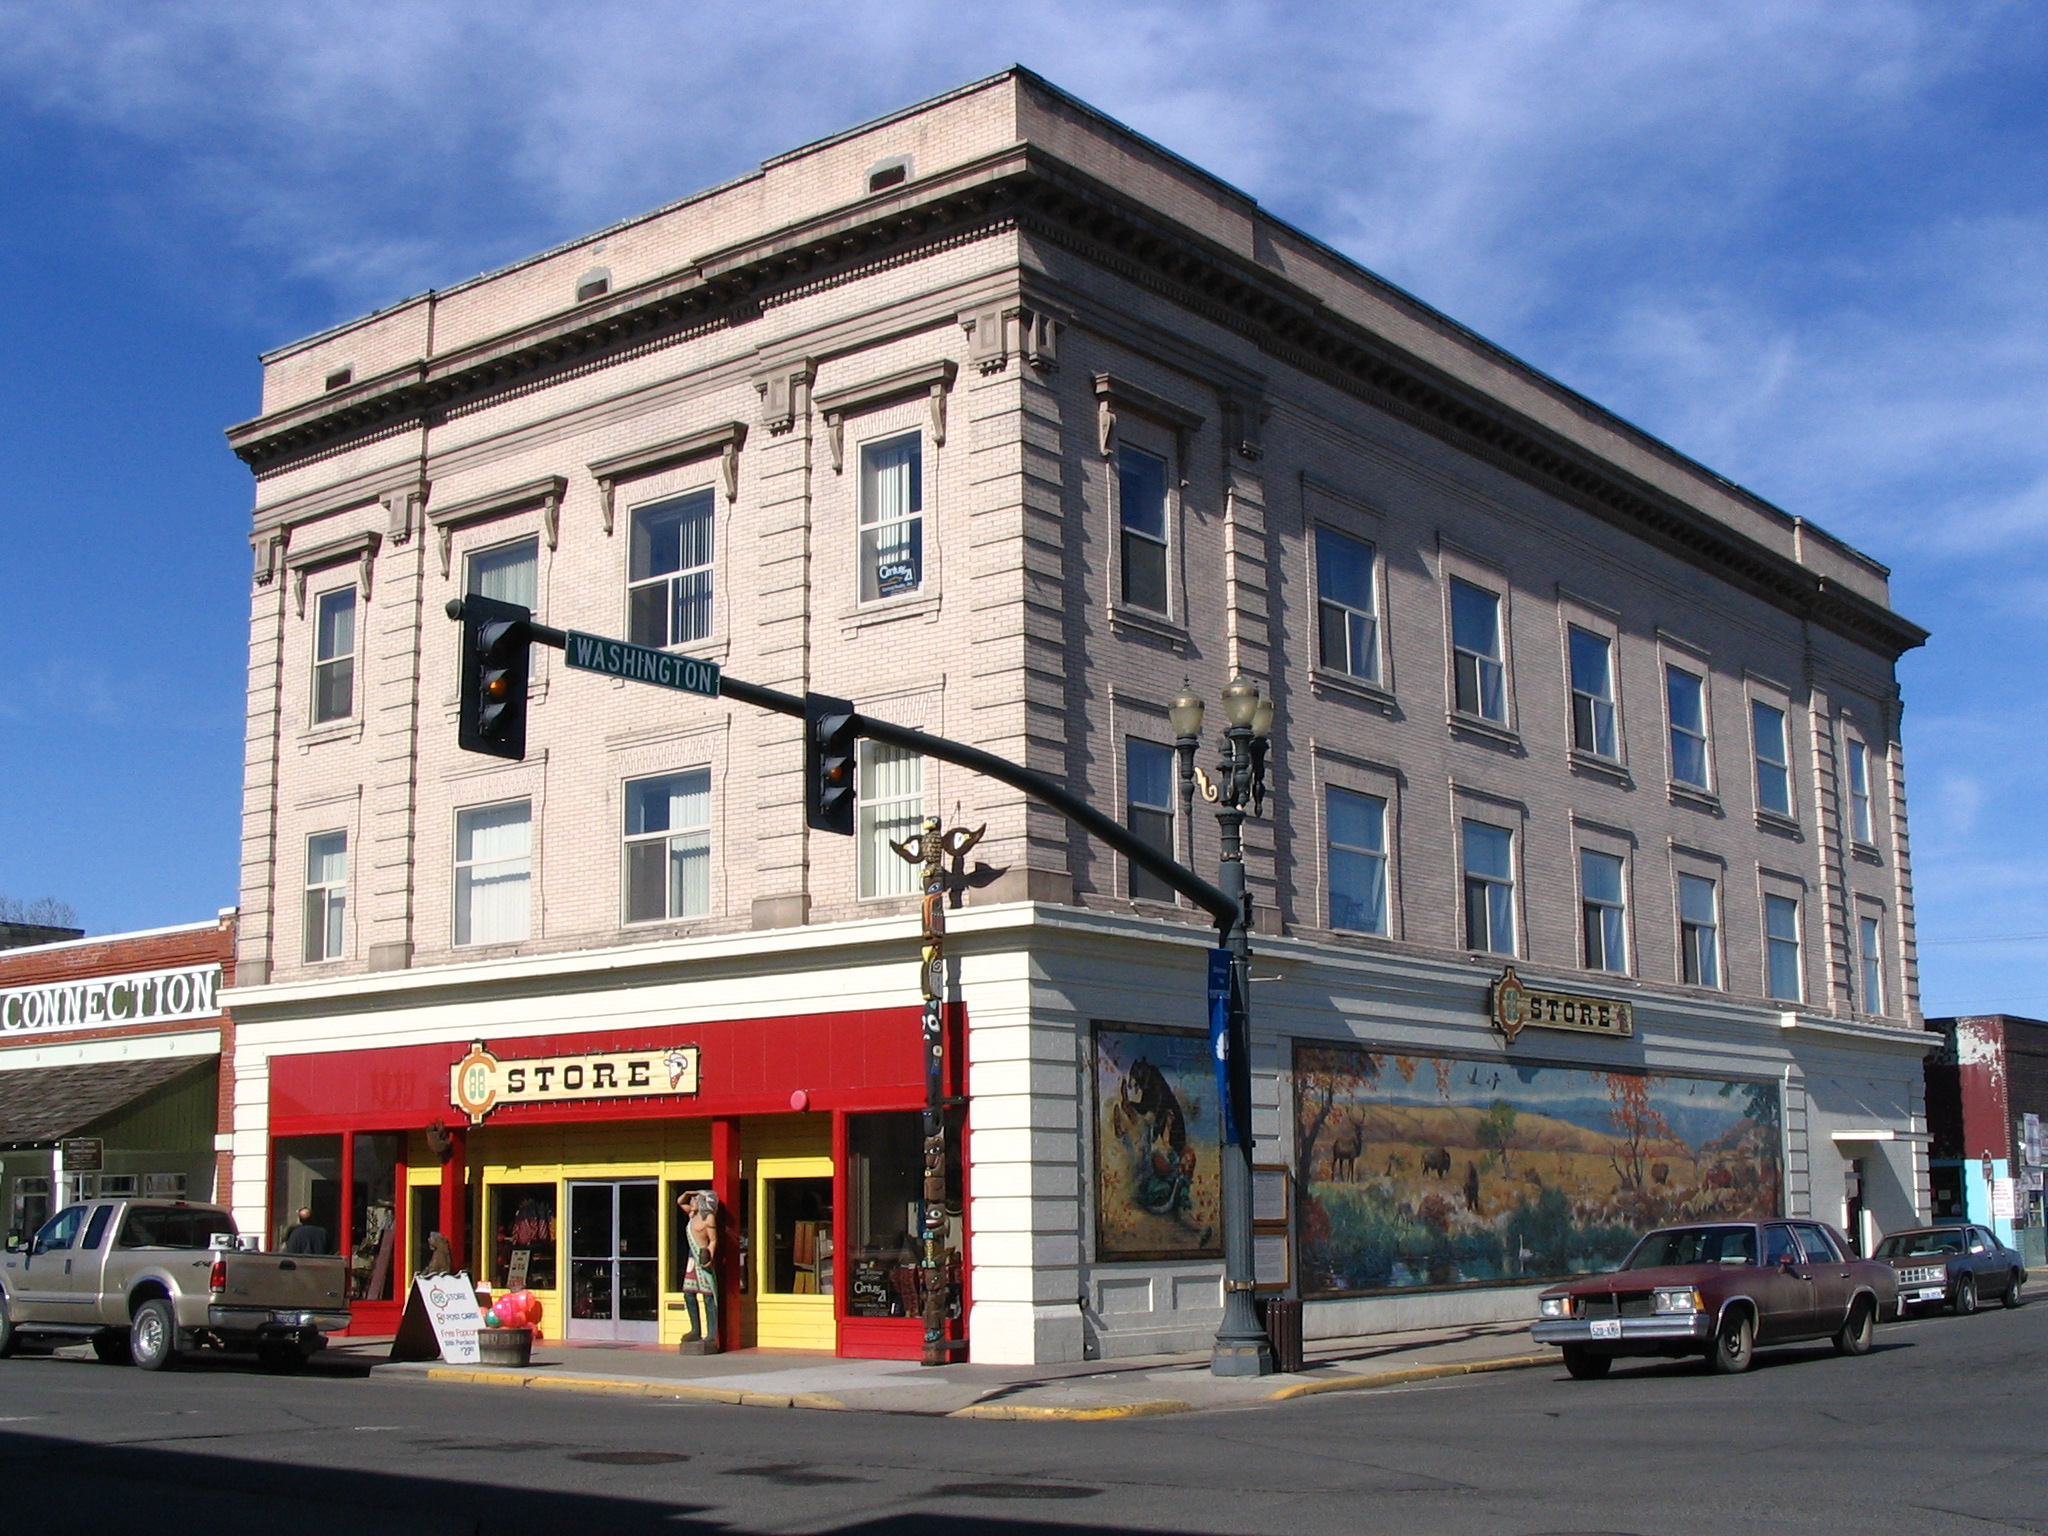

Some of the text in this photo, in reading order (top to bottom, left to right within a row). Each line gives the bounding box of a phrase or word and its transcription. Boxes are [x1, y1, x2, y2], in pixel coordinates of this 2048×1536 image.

[576, 636, 712, 693] WASHINGTON
[2, 970, 215, 1030] CONNECTION
[1530, 997, 1610, 1027] STORE
[507, 1061, 650, 1094] STORE
